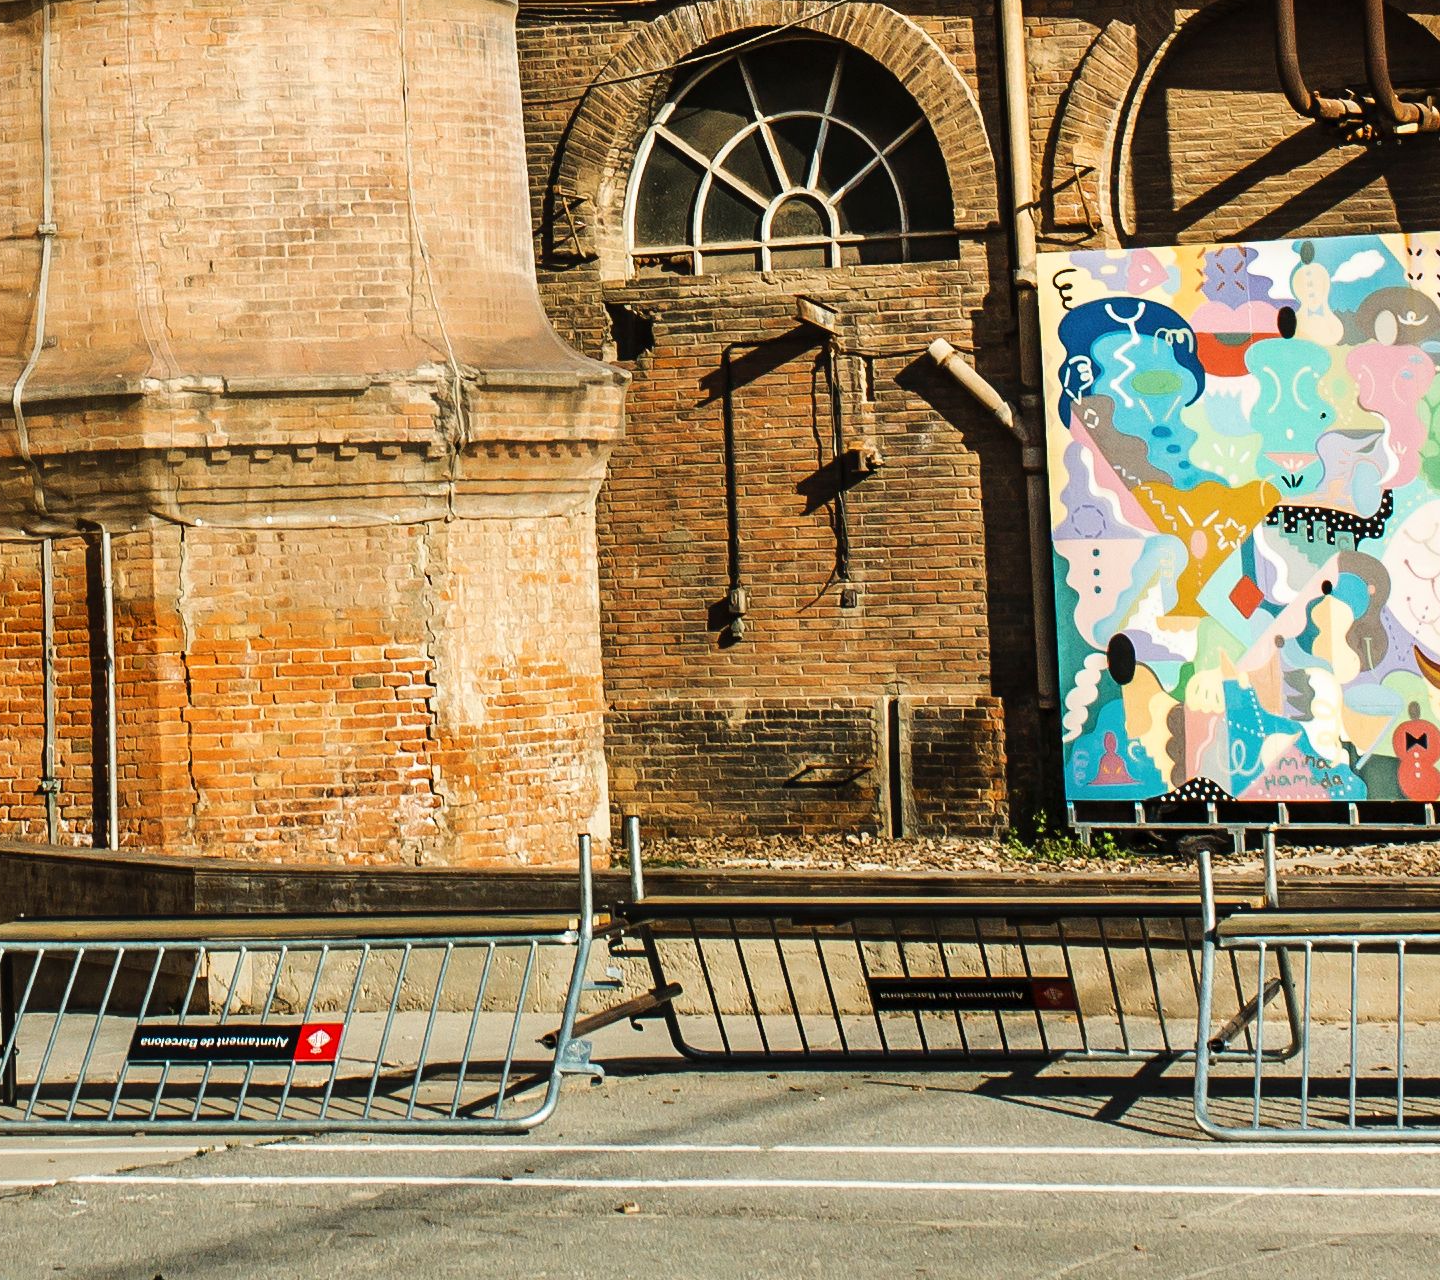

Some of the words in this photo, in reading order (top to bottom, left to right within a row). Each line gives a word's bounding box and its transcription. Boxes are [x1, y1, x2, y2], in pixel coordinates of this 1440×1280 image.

[880, 991, 936, 1001] Barcelona
[938, 991, 953, 1000] de
[956, 989, 1024, 1001] Ajuntament
[140, 1036, 198, 1049] Barcelona
[200, 1037, 216, 1048] de
[217, 1034, 289, 1049] Ajuntament
